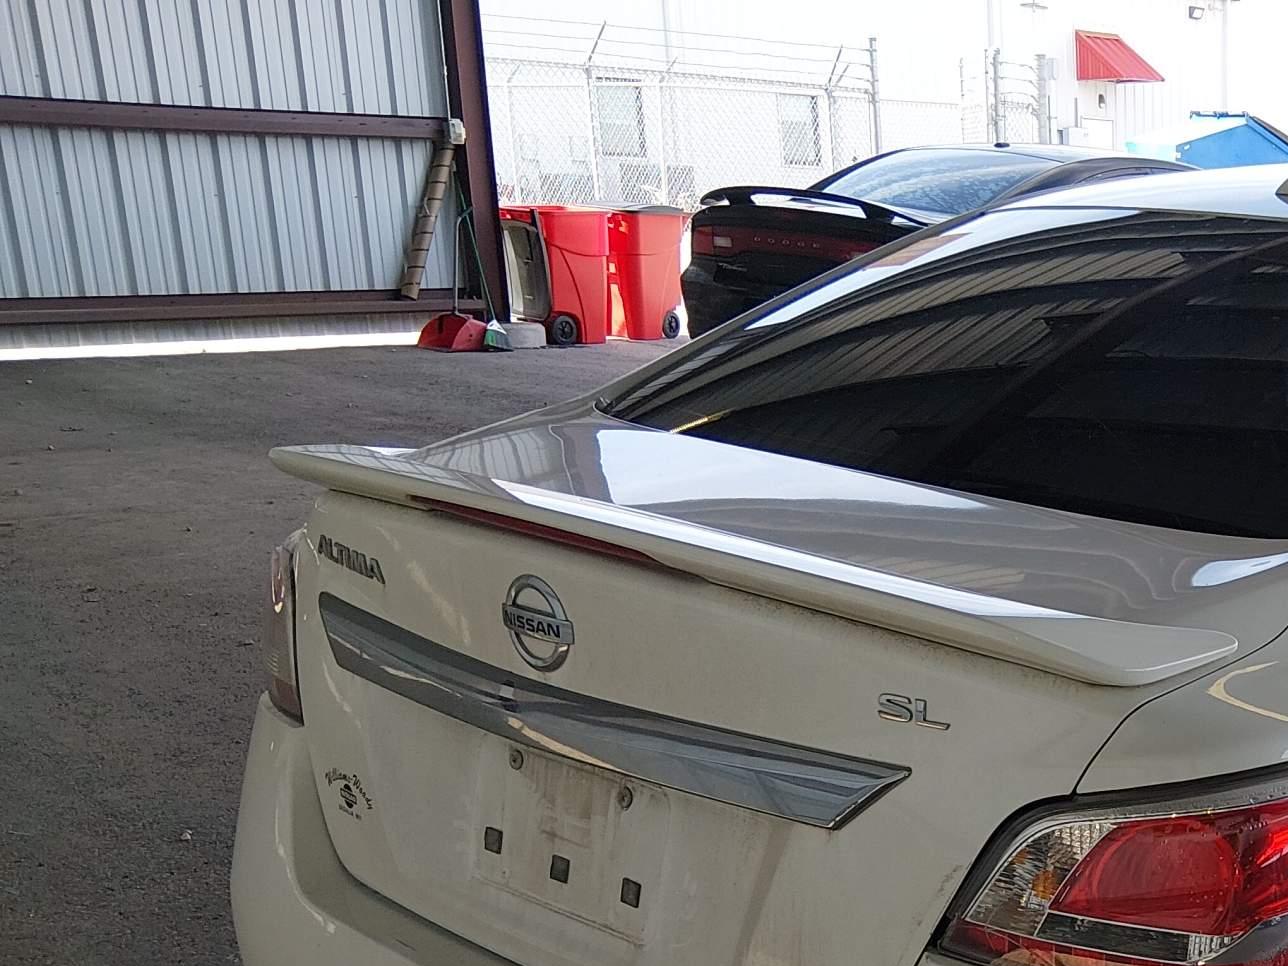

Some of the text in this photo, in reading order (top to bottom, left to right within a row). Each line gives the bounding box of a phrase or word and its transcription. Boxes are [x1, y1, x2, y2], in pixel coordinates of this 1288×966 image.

[318, 534, 386, 585] ALTIMA
[504, 610, 561, 639] NISSAN
[877, 693, 951, 731] SL
